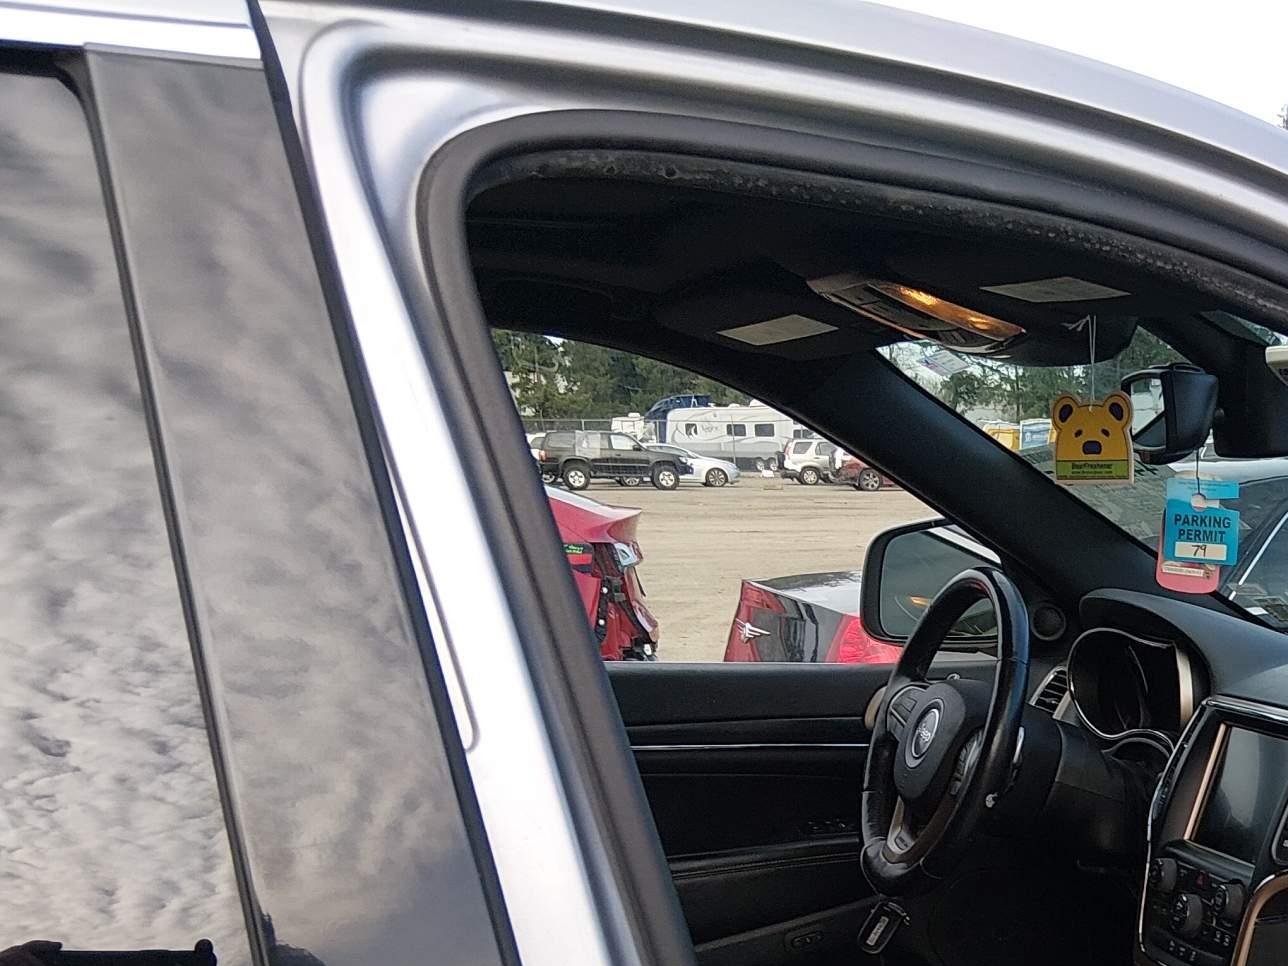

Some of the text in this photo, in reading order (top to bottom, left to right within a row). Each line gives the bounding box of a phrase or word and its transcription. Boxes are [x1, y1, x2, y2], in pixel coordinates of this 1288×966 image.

[1174, 513, 1232, 528] PARKING
[1178, 529, 1226, 543] PERMIT
[1191, 544, 1207, 558] 79
